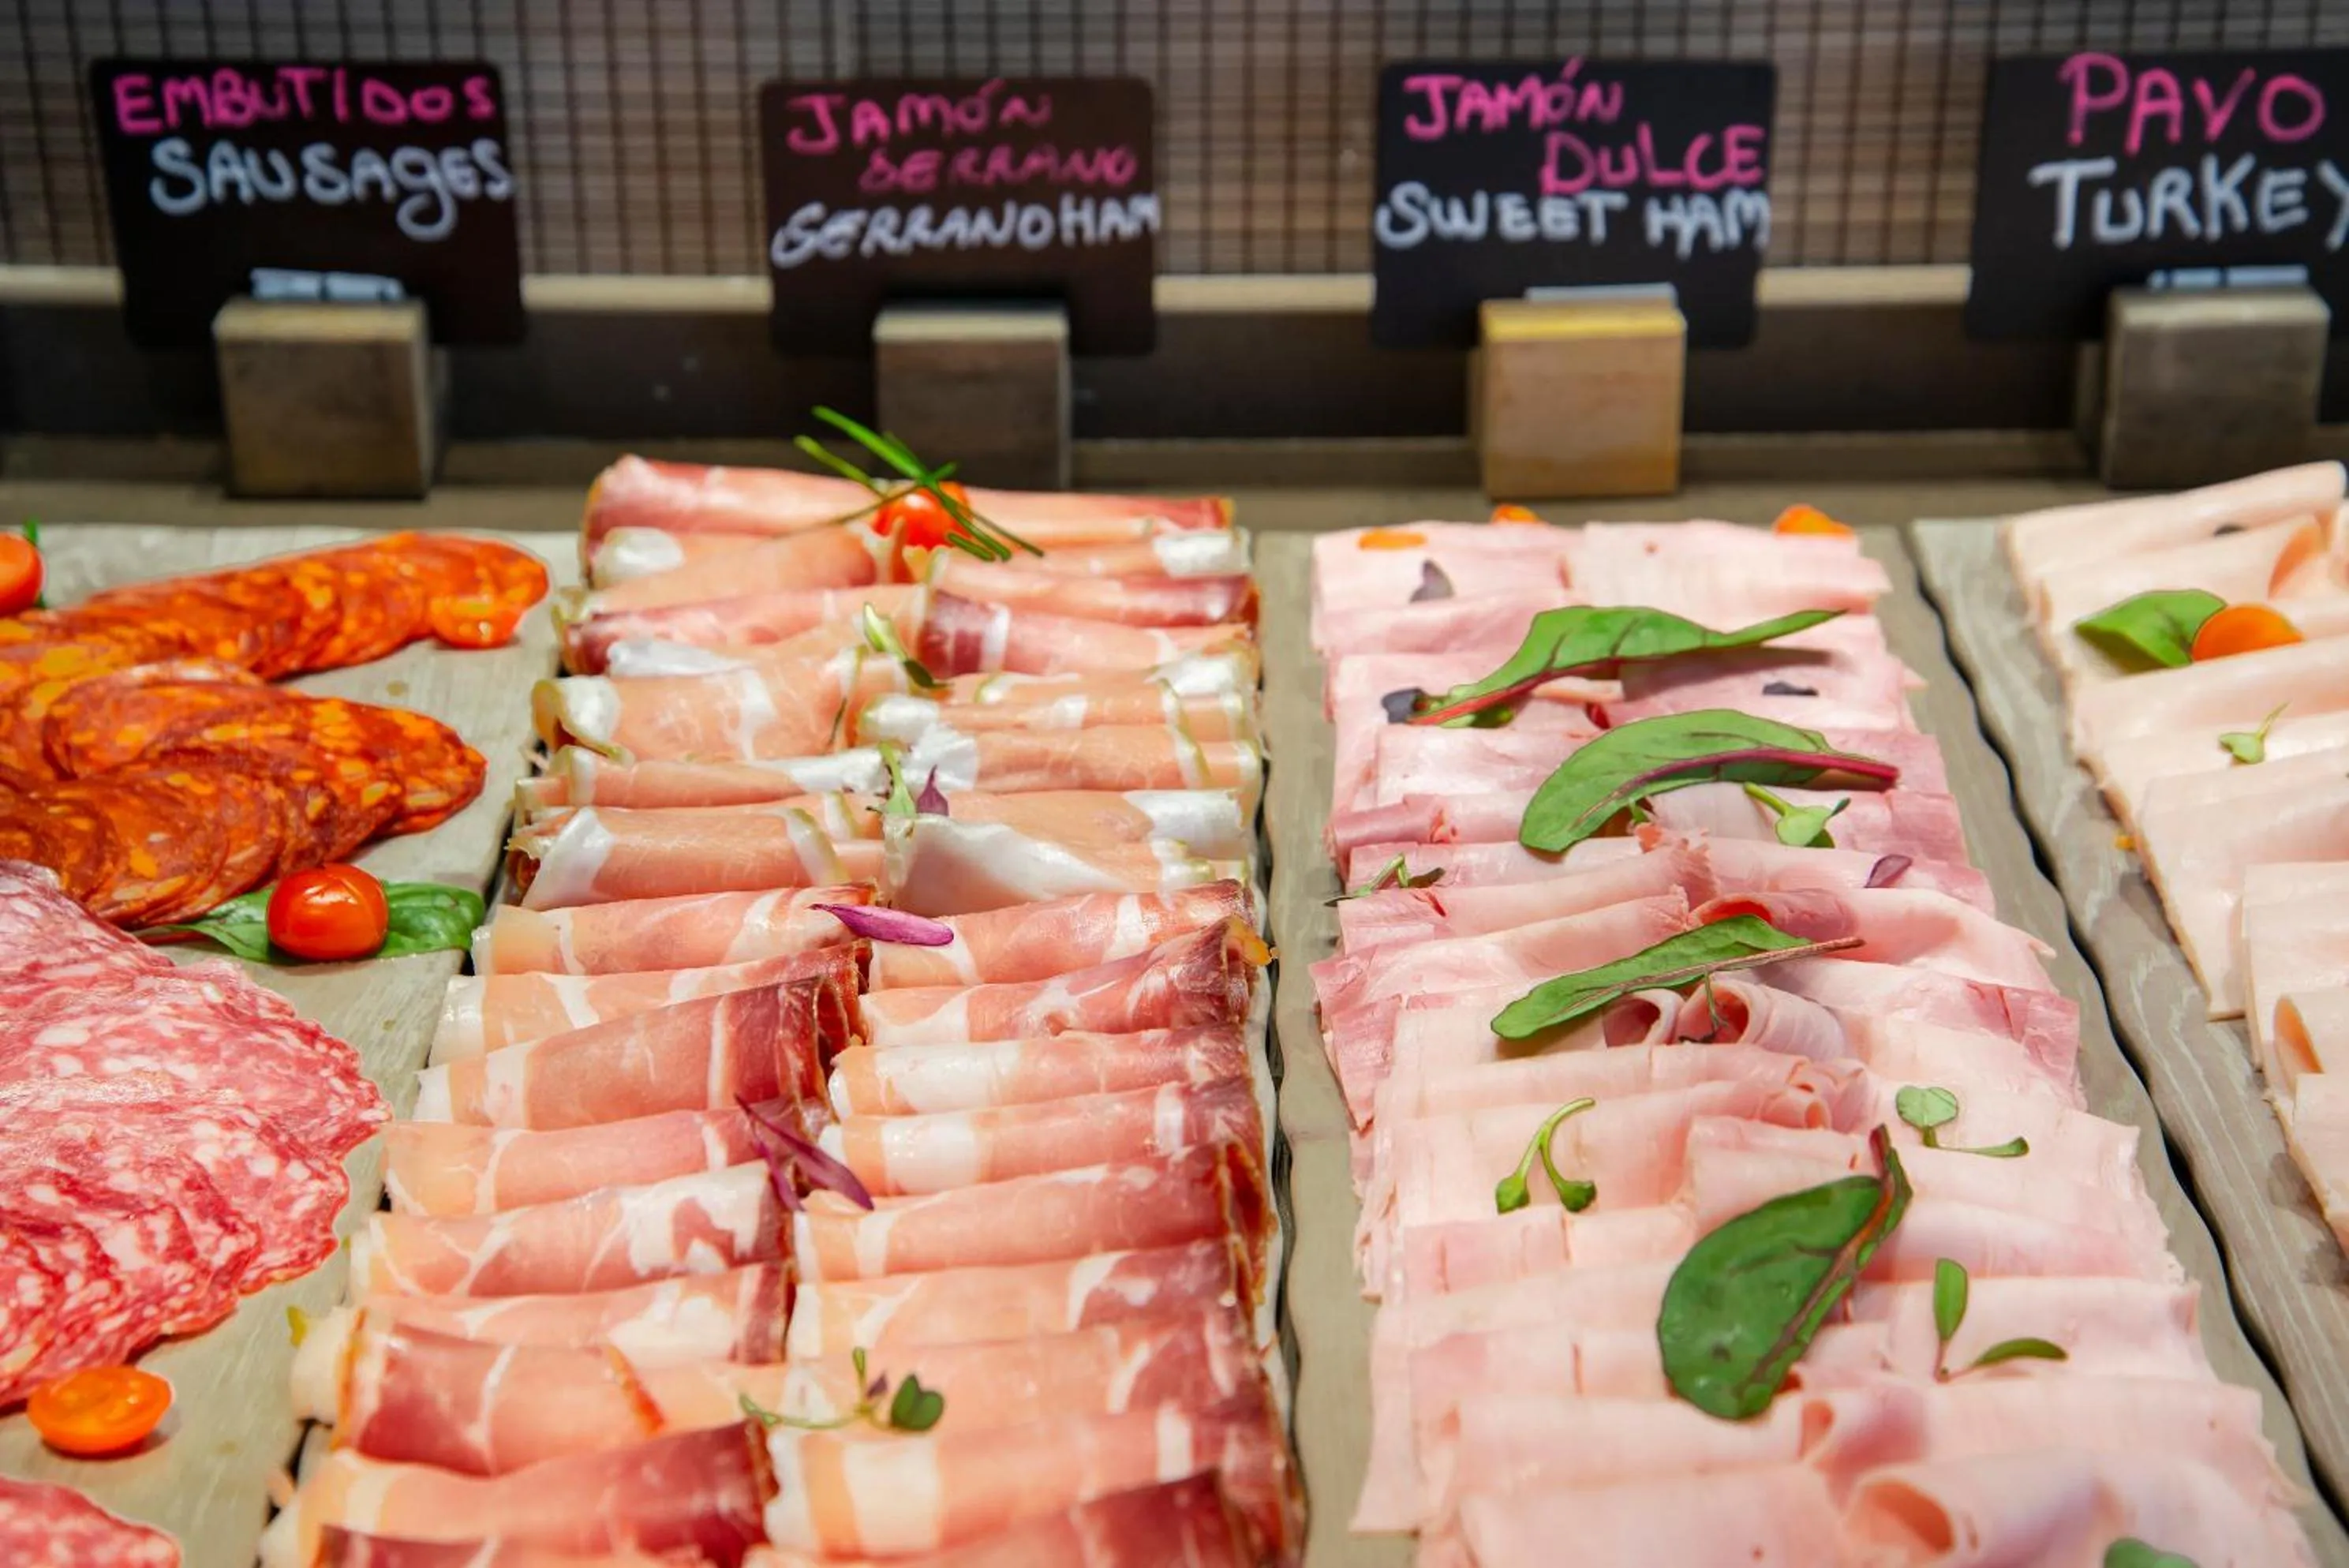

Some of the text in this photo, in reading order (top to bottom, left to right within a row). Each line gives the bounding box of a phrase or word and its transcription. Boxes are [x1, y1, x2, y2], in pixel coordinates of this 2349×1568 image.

[113, 67, 496, 133] EMBUTIDOS
[1403, 55, 1624, 140] JAMÓN
[2058, 51, 2326, 155] PAVO
[1539, 122, 1766, 196] DULCE
[1374, 181, 1772, 260] SWEET HAM
